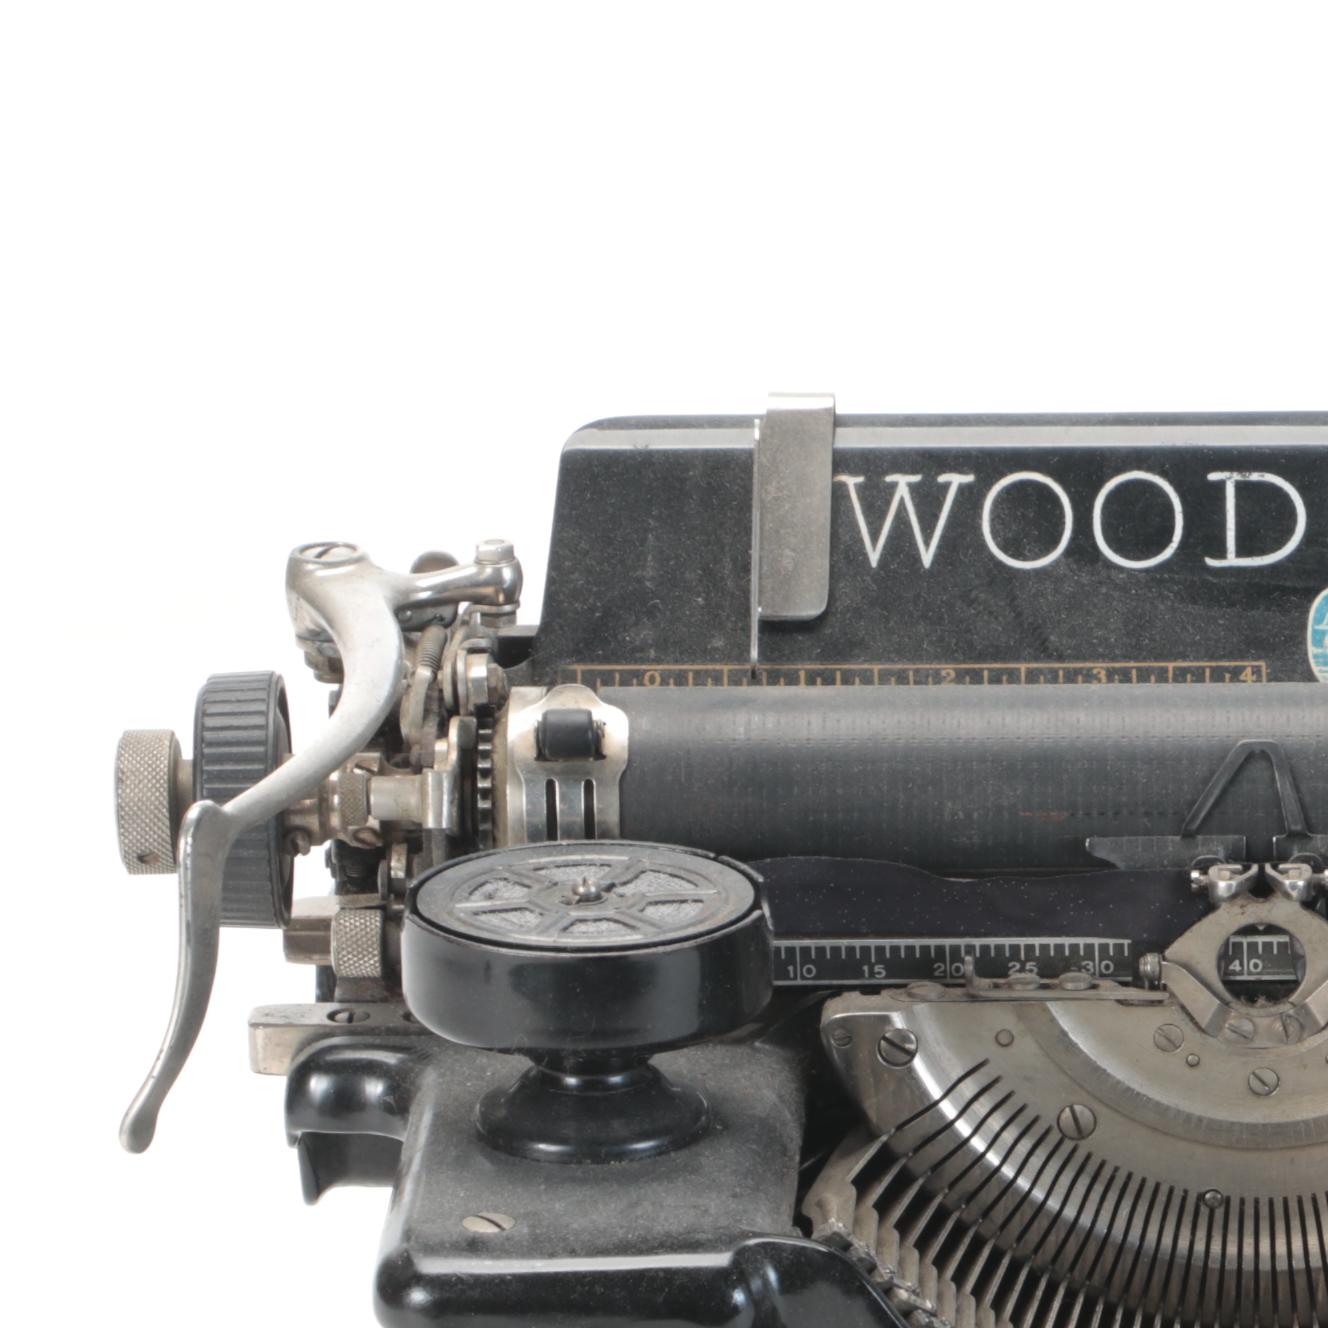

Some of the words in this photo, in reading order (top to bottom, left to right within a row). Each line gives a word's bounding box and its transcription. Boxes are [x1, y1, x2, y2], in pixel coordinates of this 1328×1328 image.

[940, 669, 956, 685] 2
[1092, 667, 1108, 683] 3
[1239, 666, 1257, 682] 4
[786, 964, 817, 978] 10
[862, 963, 886, 978] 15
[933, 962, 964, 977] 20
[1007, 961, 1038, 975] 25
[1082, 960, 1114, 974] 30
[1228, 958, 1264, 973] 40
